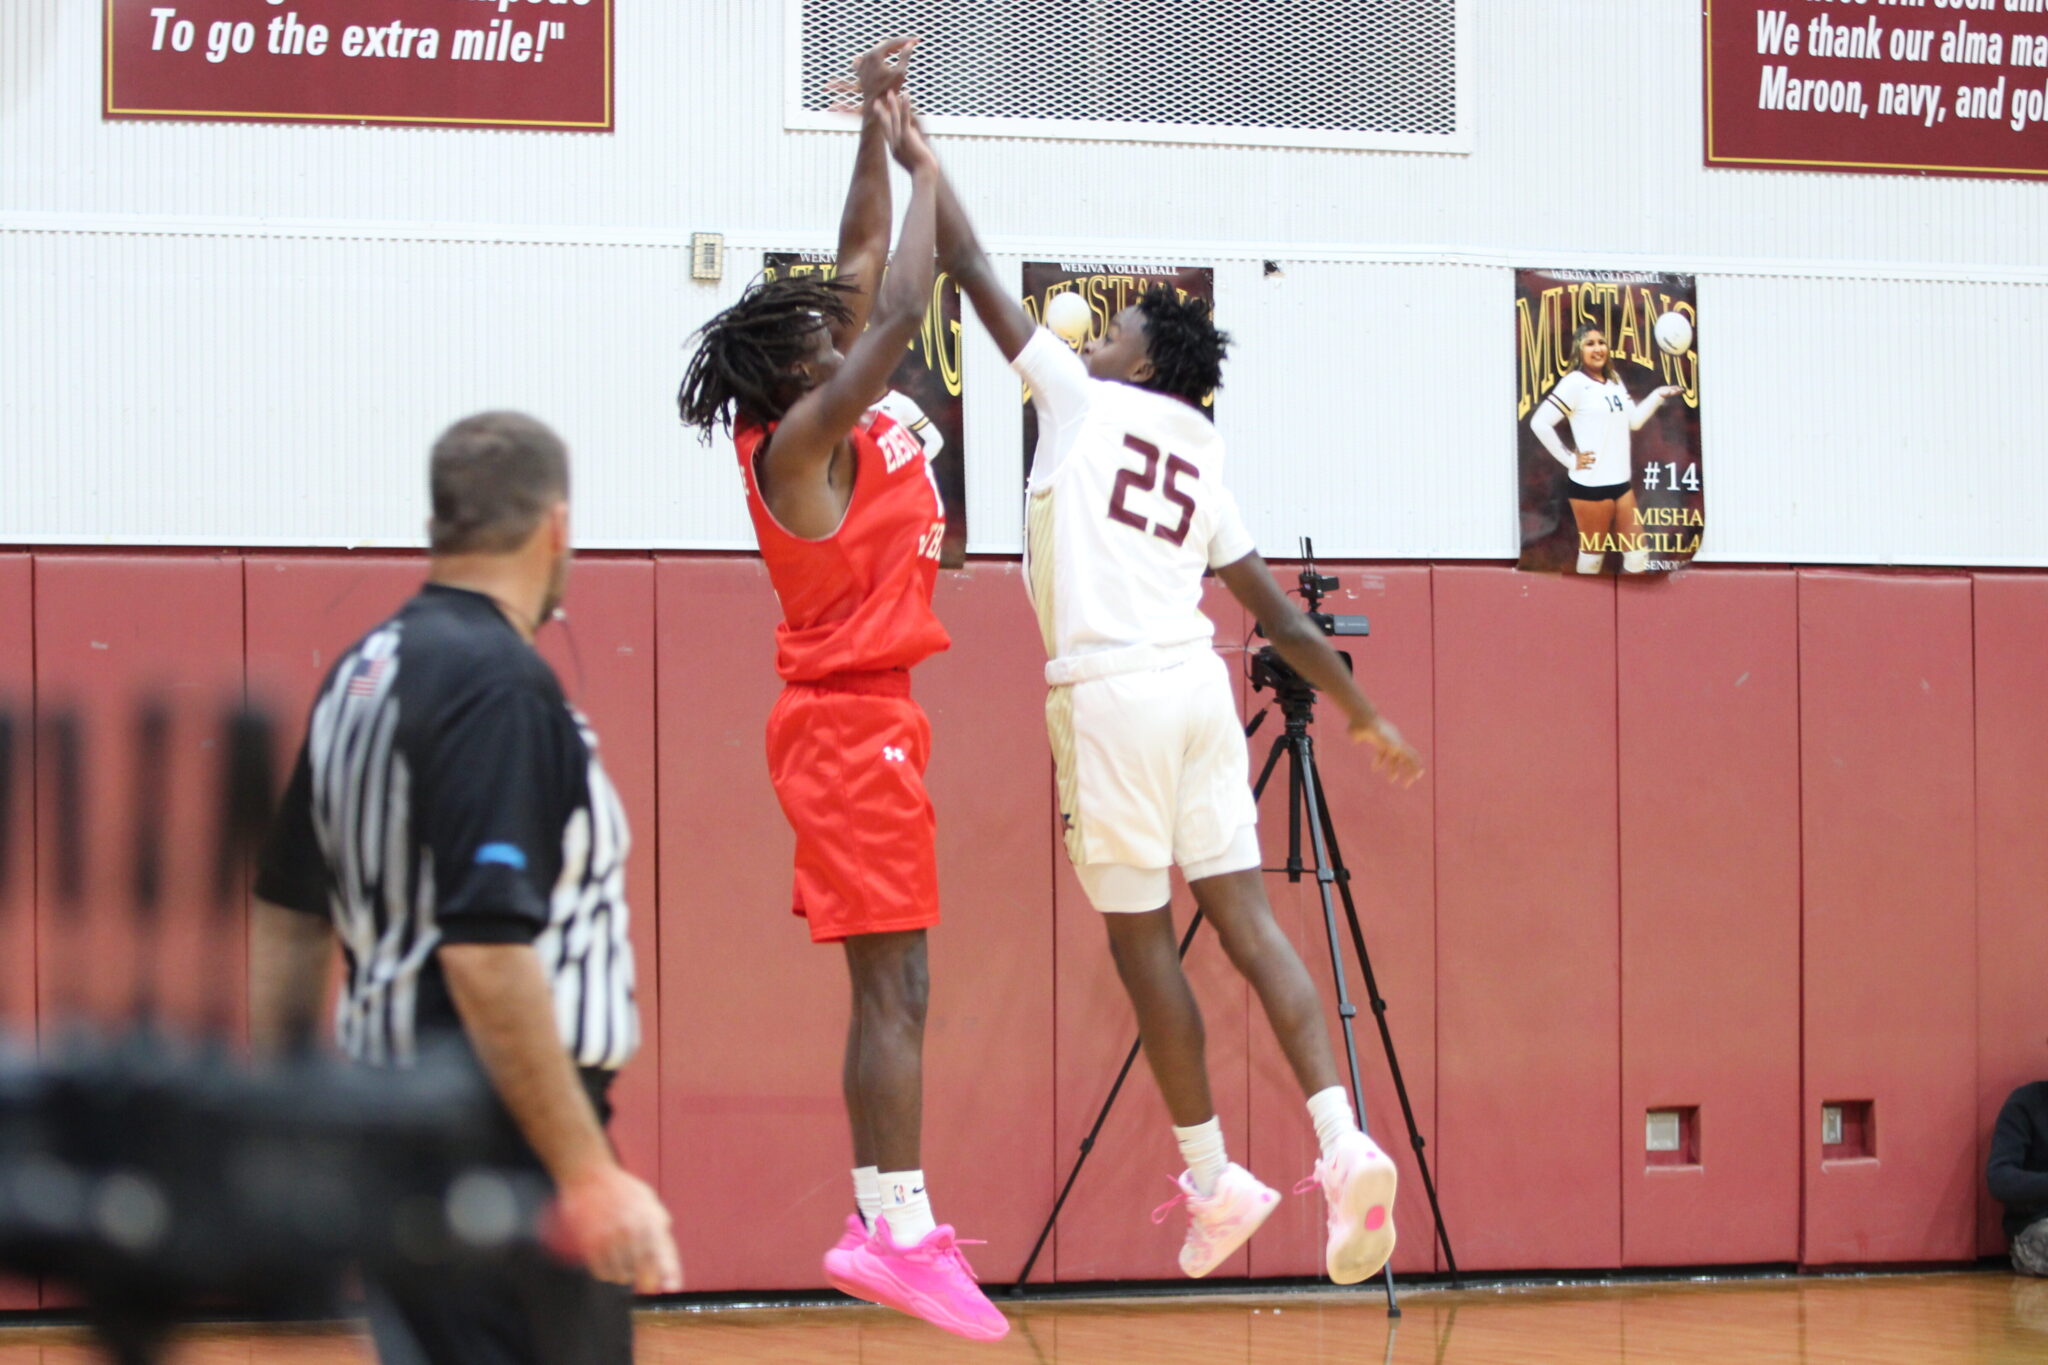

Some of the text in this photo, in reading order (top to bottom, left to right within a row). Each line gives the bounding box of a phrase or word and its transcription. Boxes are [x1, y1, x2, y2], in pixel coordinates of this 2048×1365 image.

[151, 8, 565, 63] To go the extra mile!"
[1757, 10, 2048, 67] We thank our alma ma
[1758, 65, 1868, 119] Maroon,
[1877, 82, 1946, 127] navy,
[1955, 76, 2005, 119] and
[1060, 263, 1179, 275] WEKIVA VOLLEYBALL
[1551, 270, 1663, 284] WEKIVA VOLLEYBALL
[1107, 433, 1200, 547] 25
[1643, 461, 1700, 491] #14
[1632, 507, 1704, 526] MISHA
[1578, 532, 1702, 553] MANCILLA
